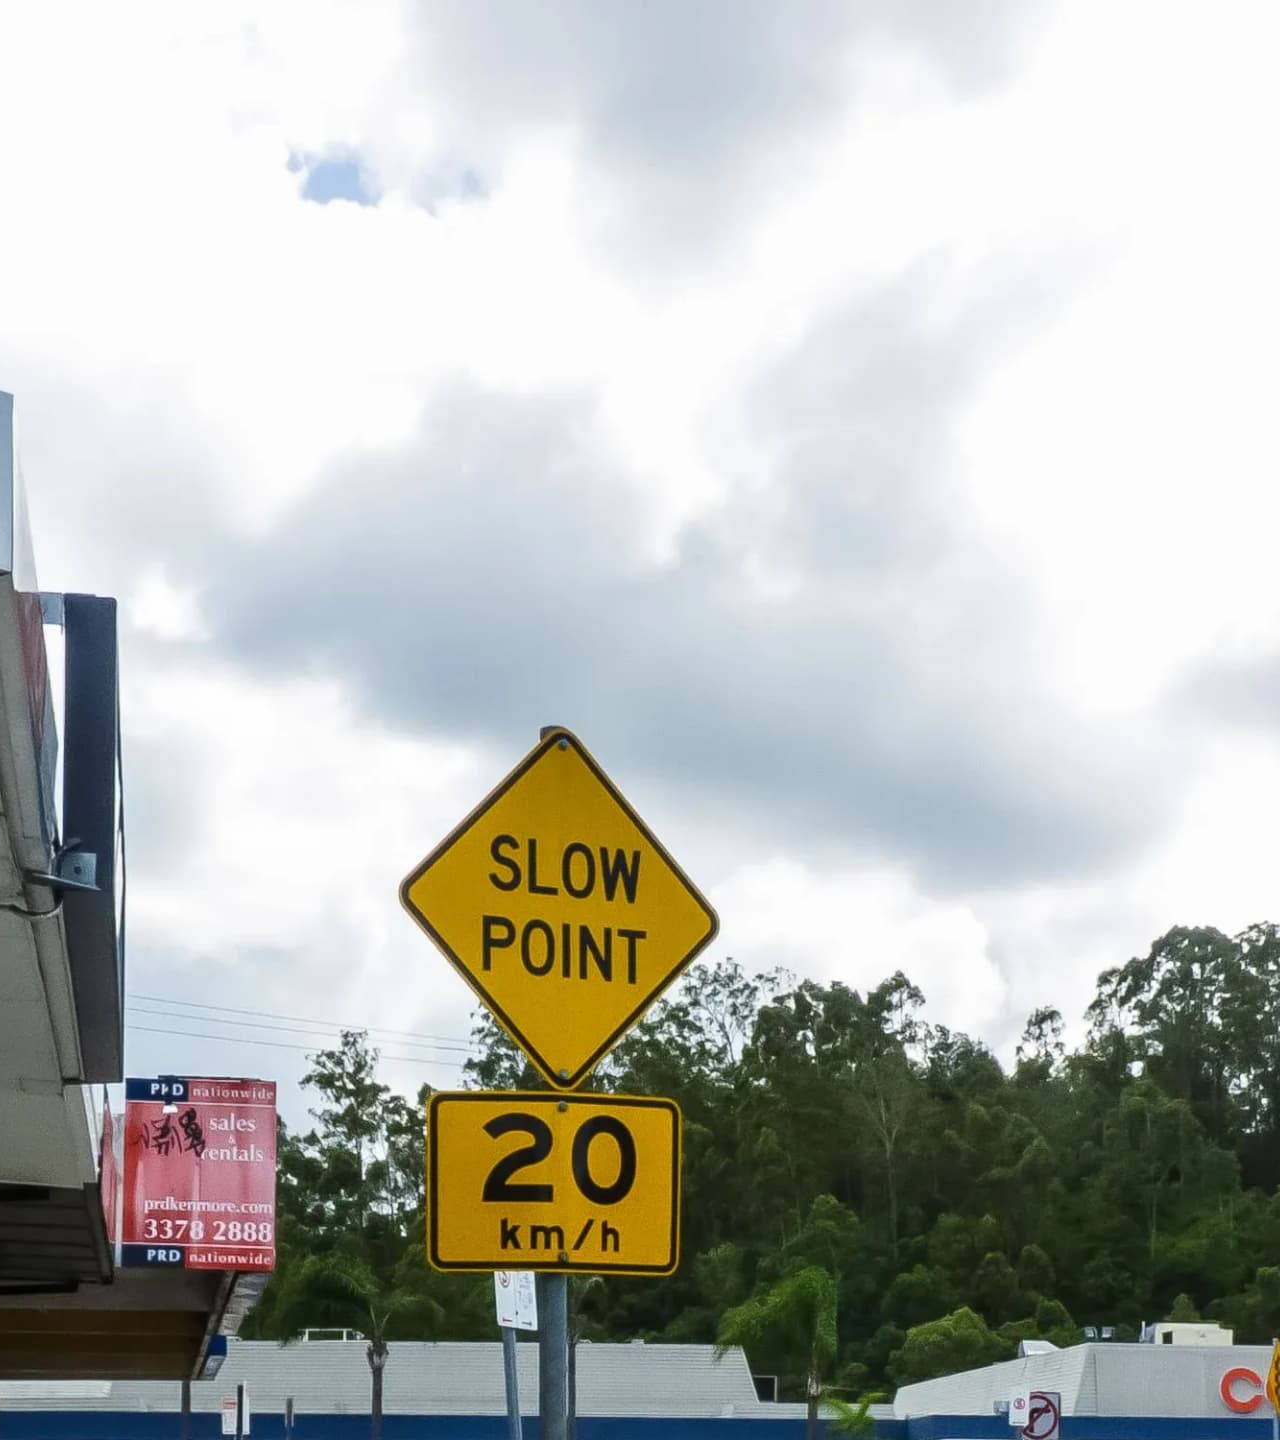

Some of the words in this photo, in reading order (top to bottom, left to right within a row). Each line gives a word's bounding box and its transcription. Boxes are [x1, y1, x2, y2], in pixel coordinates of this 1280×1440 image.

[488, 833, 642, 904] SLOW
[481, 915, 647, 985] POINT
[192, 1087, 274, 1100] nationwide
[208, 1113, 257, 1132] sales
[200, 1145, 265, 1162] rentals
[481, 1112, 638, 1206] 20
[144, 1197, 273, 1214] prdkenmore.com
[144, 1218, 204, 1241] 3378
[212, 1221, 273, 1243] 2888
[499, 1217, 620, 1252] km/h
[146, 1249, 181, 1262] PRD
[189, 1251, 271, 1265] nationwide
